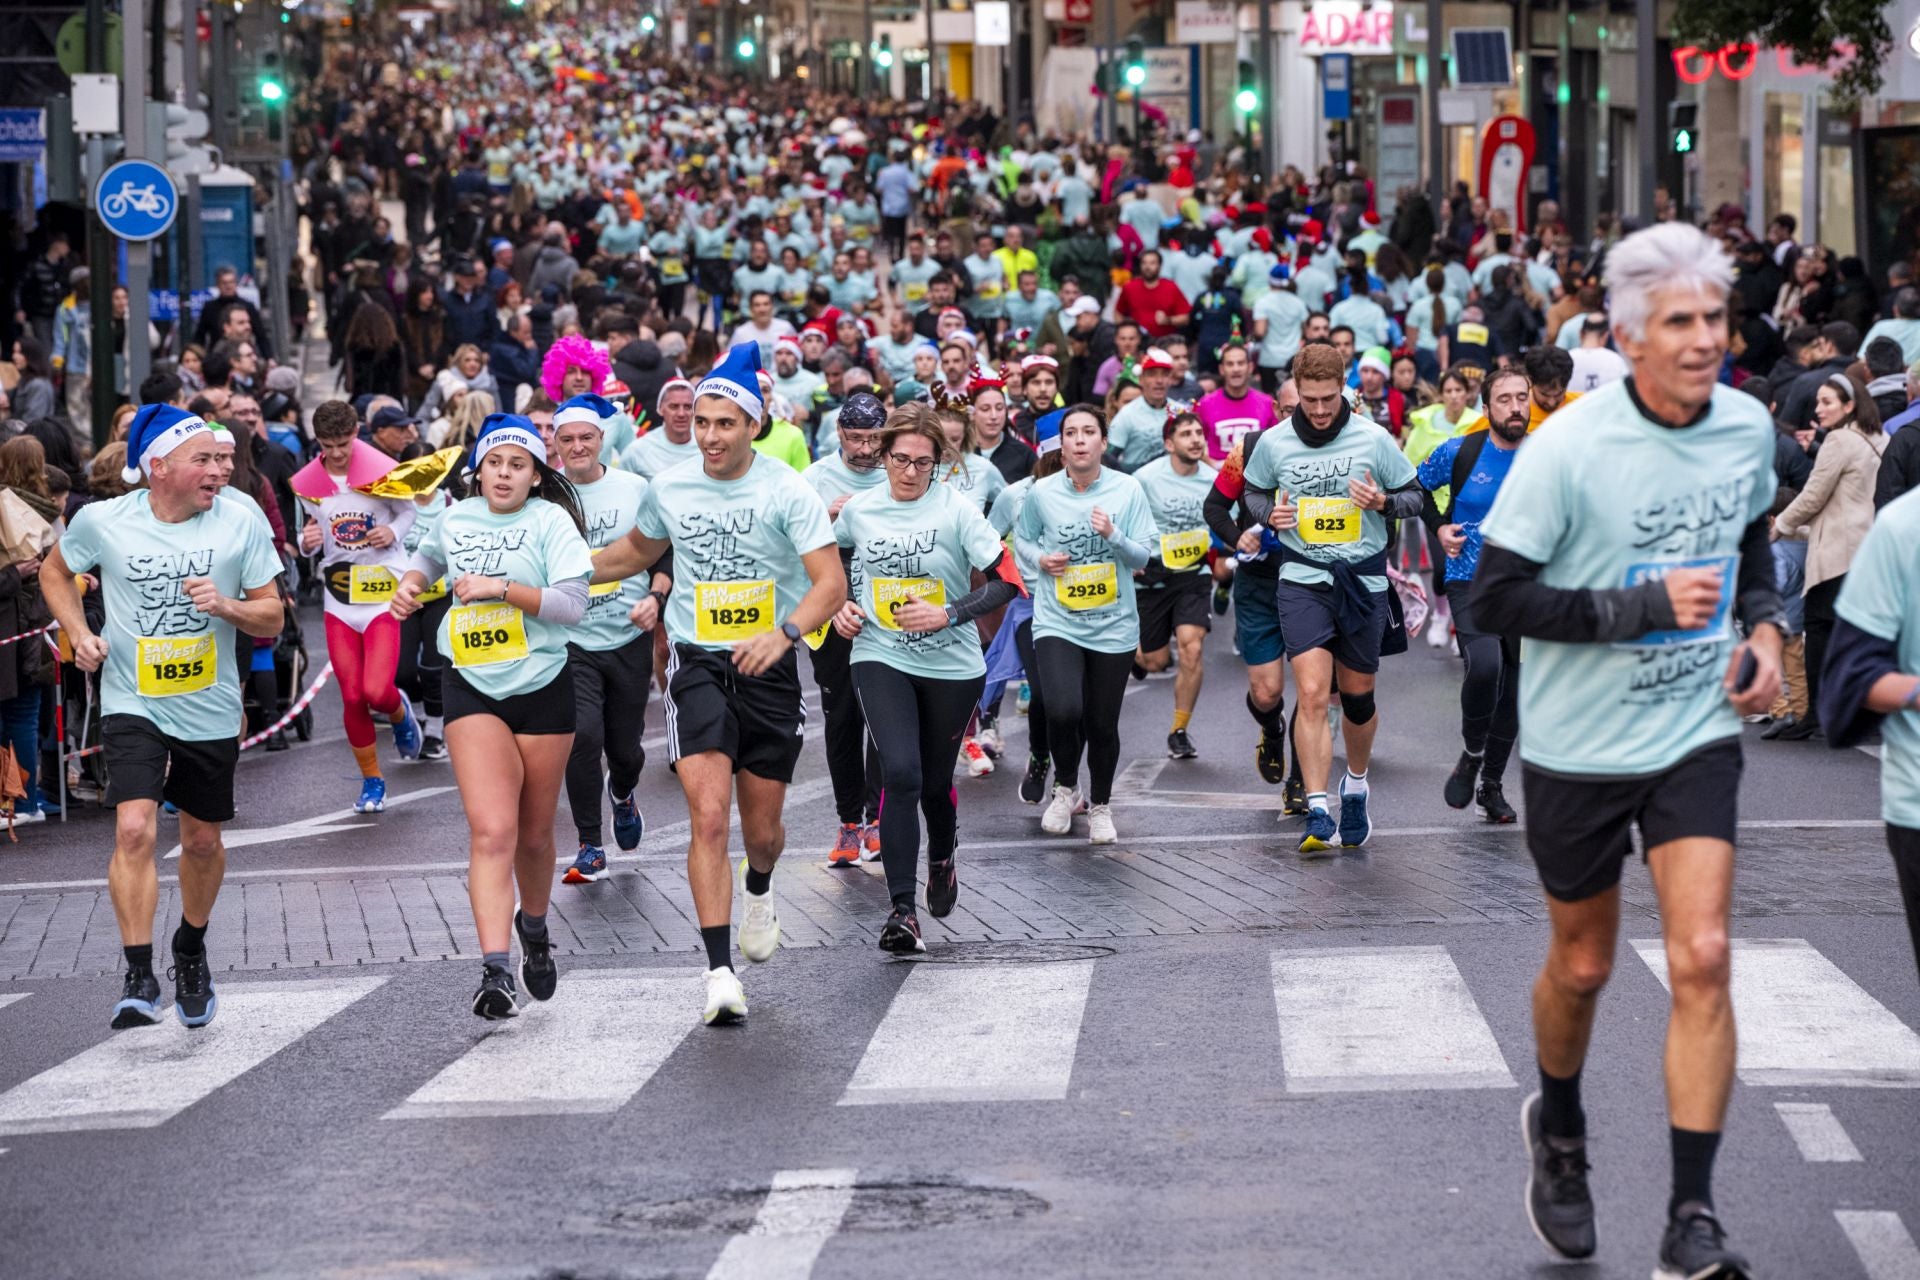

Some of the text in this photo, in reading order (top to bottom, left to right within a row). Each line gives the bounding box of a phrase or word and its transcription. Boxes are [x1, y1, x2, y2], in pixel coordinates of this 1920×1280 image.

[1291, 456, 1352, 485] SAN
[678, 508, 754, 541] SAN
[1314, 518, 1346, 531] 823
[1632, 479, 1742, 548] SAN
[449, 528, 528, 556] SAN
[690, 534, 746, 564] SIL
[866, 529, 938, 564] SAN
[1172, 546, 1201, 559] 1358
[126, 548, 214, 582] SAN
[360, 581, 393, 593] 2523
[701, 585, 729, 600] SAN
[701, 582, 769, 611] SILVESTRE
[1066, 582, 1108, 598] 2928
[133, 606, 210, 637] VES
[454, 605, 516, 636] SILVESTRE
[456, 608, 478, 623] SAN
[709, 607, 760, 625] 1829
[143, 641, 173, 655] SAN
[461, 628, 509, 649] 1830
[153, 659, 204, 680] 1835
